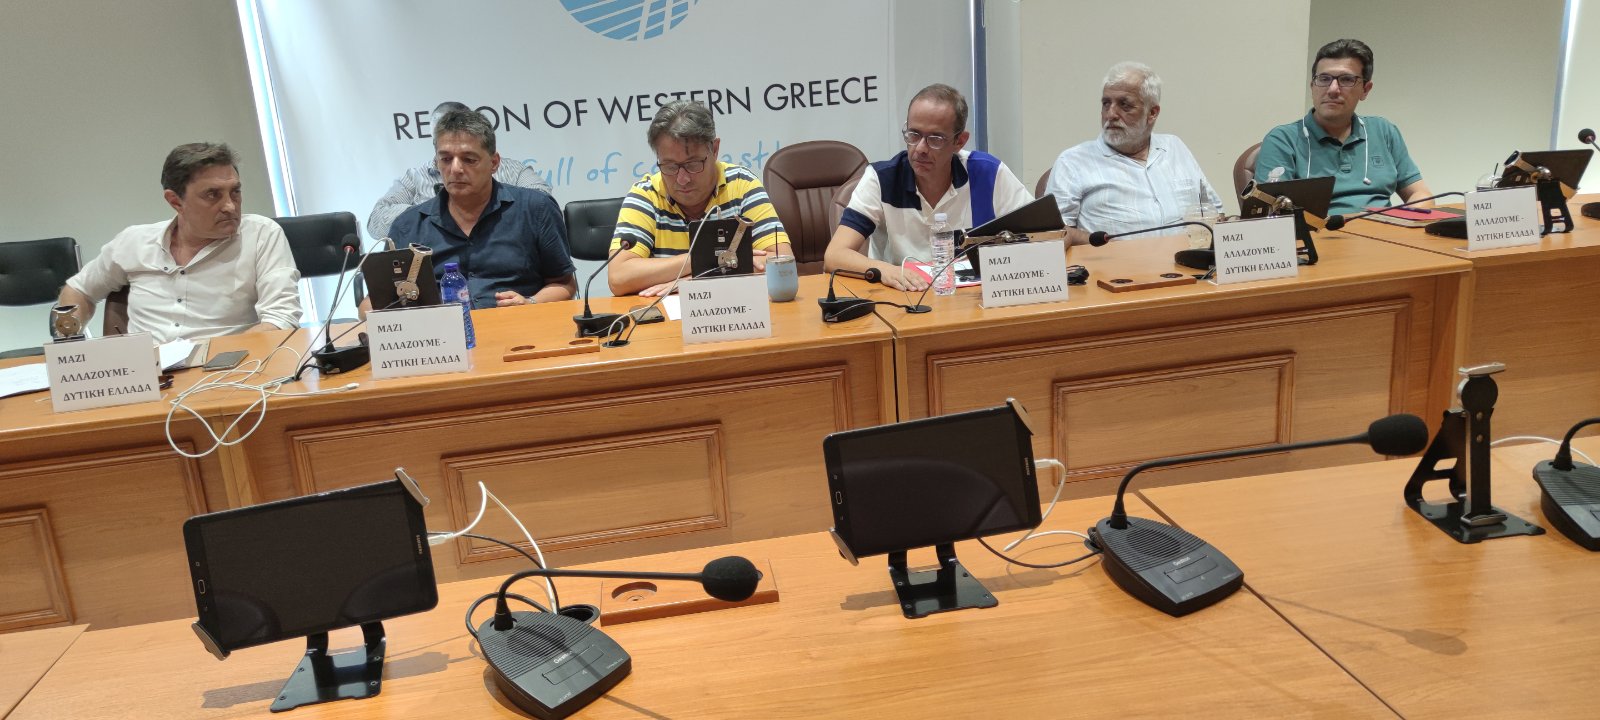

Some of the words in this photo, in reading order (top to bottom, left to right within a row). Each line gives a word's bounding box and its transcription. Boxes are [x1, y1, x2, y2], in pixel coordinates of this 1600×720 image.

[393, 103, 531, 140] REON
[543, 99, 588, 129] OF
[763, 76, 878, 111] GREECE
[586, 151, 623, 184] of
[1473, 203, 1492, 211] ΜΑΖΙ
[1475, 215, 1520, 226] ΑΛΛΑΖΟΥΜΕ
[1222, 234, 1244, 242] ΜΑΖΙ
[1476, 232, 1503, 241] ΔΥΤΙΚΗ
[1505, 229, 1535, 238] ΕΛΛΑΔΑ
[1224, 246, 1275, 259] ΑΛΛΑΖΟΥΜΕ
[989, 257, 1011, 266] ΜΑΖΙ
[1225, 265, 1256, 275] ΔΥΤΙΚΗ
[1259, 261, 1292, 271] ΕΛΛΑΔΑ
[990, 270, 1045, 282] ΑΛΛΑΖΟΥΜΕ
[688, 291, 712, 300] ΜΑΖΙ
[992, 288, 1025, 298] ΔΥΤΙΚΗ
[1027, 284, 1062, 295] ΕΛΛΑΔΑ
[690, 306, 746, 317] ΑΛΛΑΖΟΥΜΕ
[377, 324, 402, 333] ΜΑΖΙ
[691, 324, 726, 334] ΔΥΤΙΚΗ
[728, 321, 765, 331] ΕΛΛΑΔΑ
[380, 339, 441, 351] ΑΛΛΑΖΟΥΜΕ
[58, 354, 86, 364] ΜΑΖΙ
[381, 358, 418, 369] ΔΥΤΙΚΗ
[421, 354, 461, 365] ΕΛΛΑΔΑ
[60, 368, 129, 383] ΑΛΛΑΖΟΥΜΕ
[64, 389, 105, 401] ΔΥΤΙΚΗ
[108, 384, 152, 396] ΕΛΛΑΔΑ
